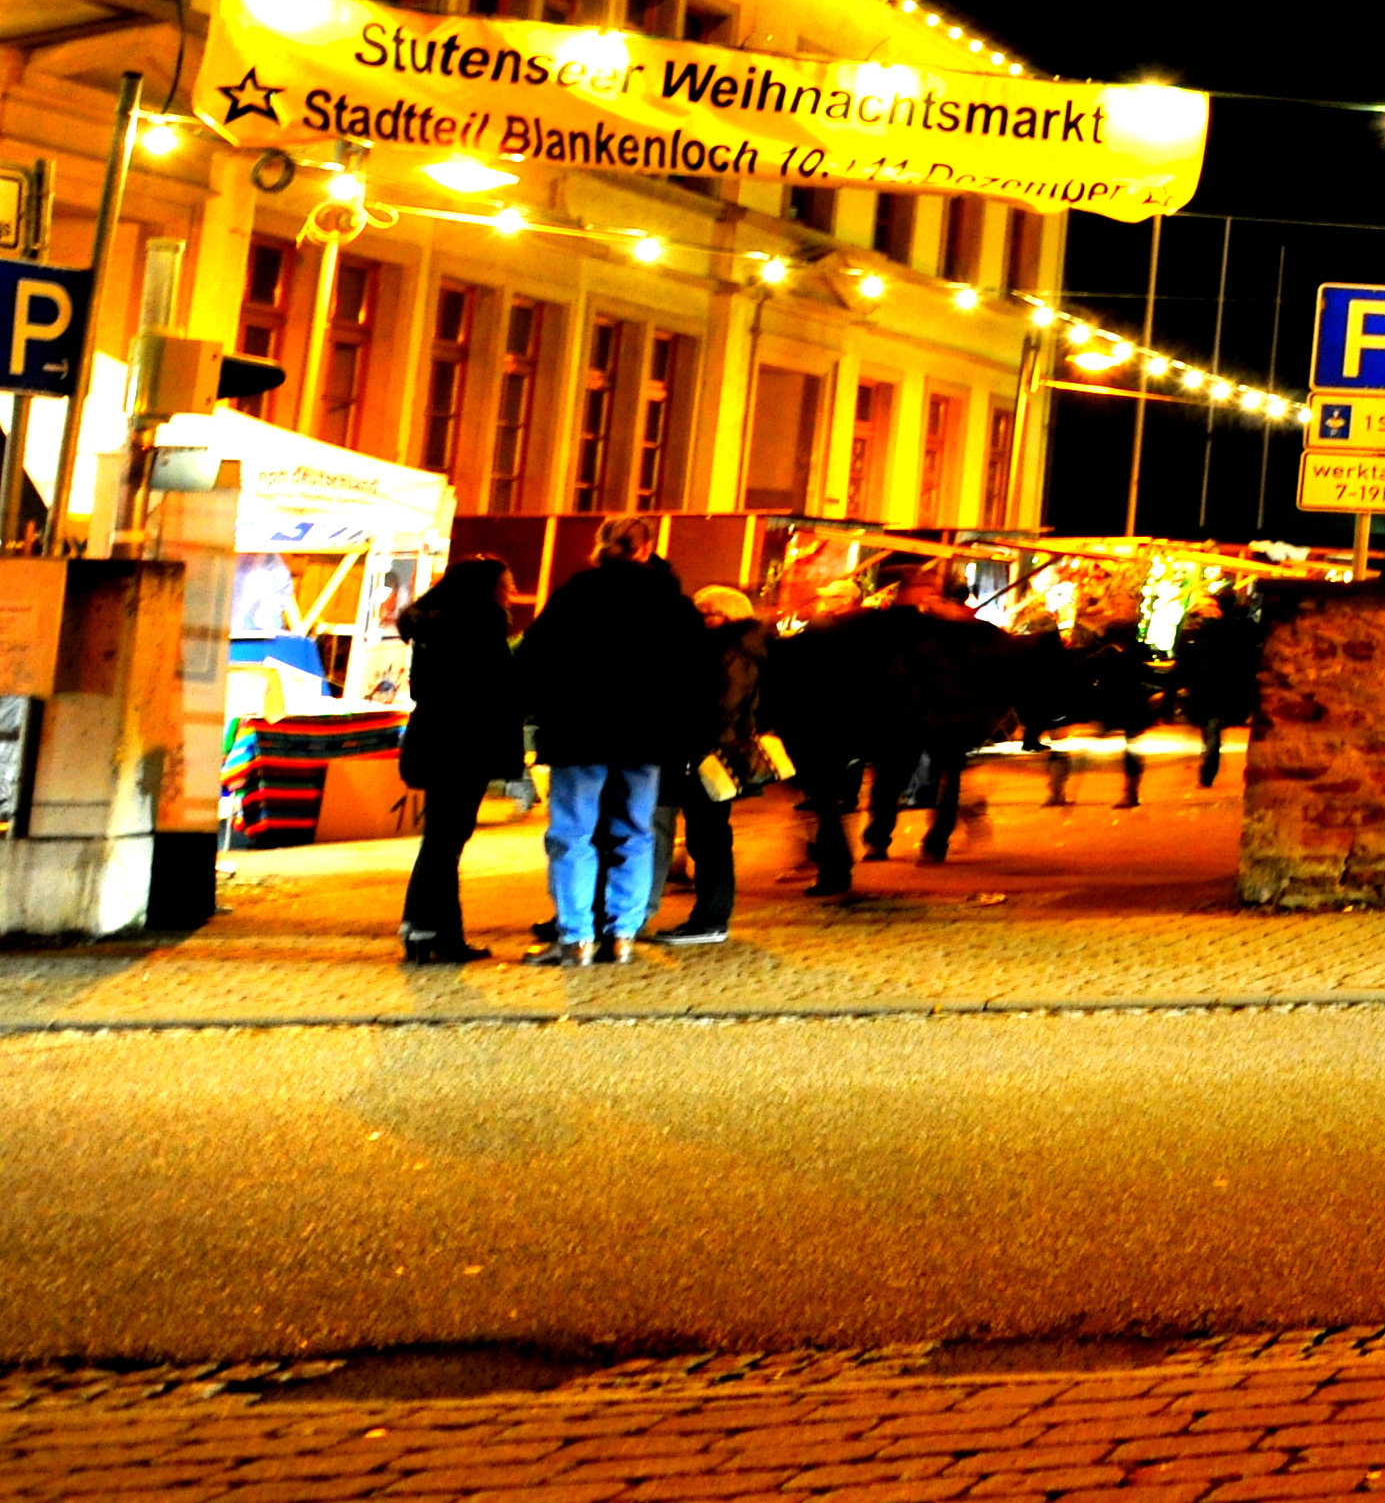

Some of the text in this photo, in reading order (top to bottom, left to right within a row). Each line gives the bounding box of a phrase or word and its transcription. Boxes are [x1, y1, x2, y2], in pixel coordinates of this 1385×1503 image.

[354, 21, 1105, 144] Stutenseer Weihnachtsmarkt
[302, 89, 490, 149] Stadtteil
[499, 114, 759, 174] Blankenloch
[780, 146, 829, 179] 10.
[9, 277, 73, 376] P
[1364, 415, 1372, 432] 1
